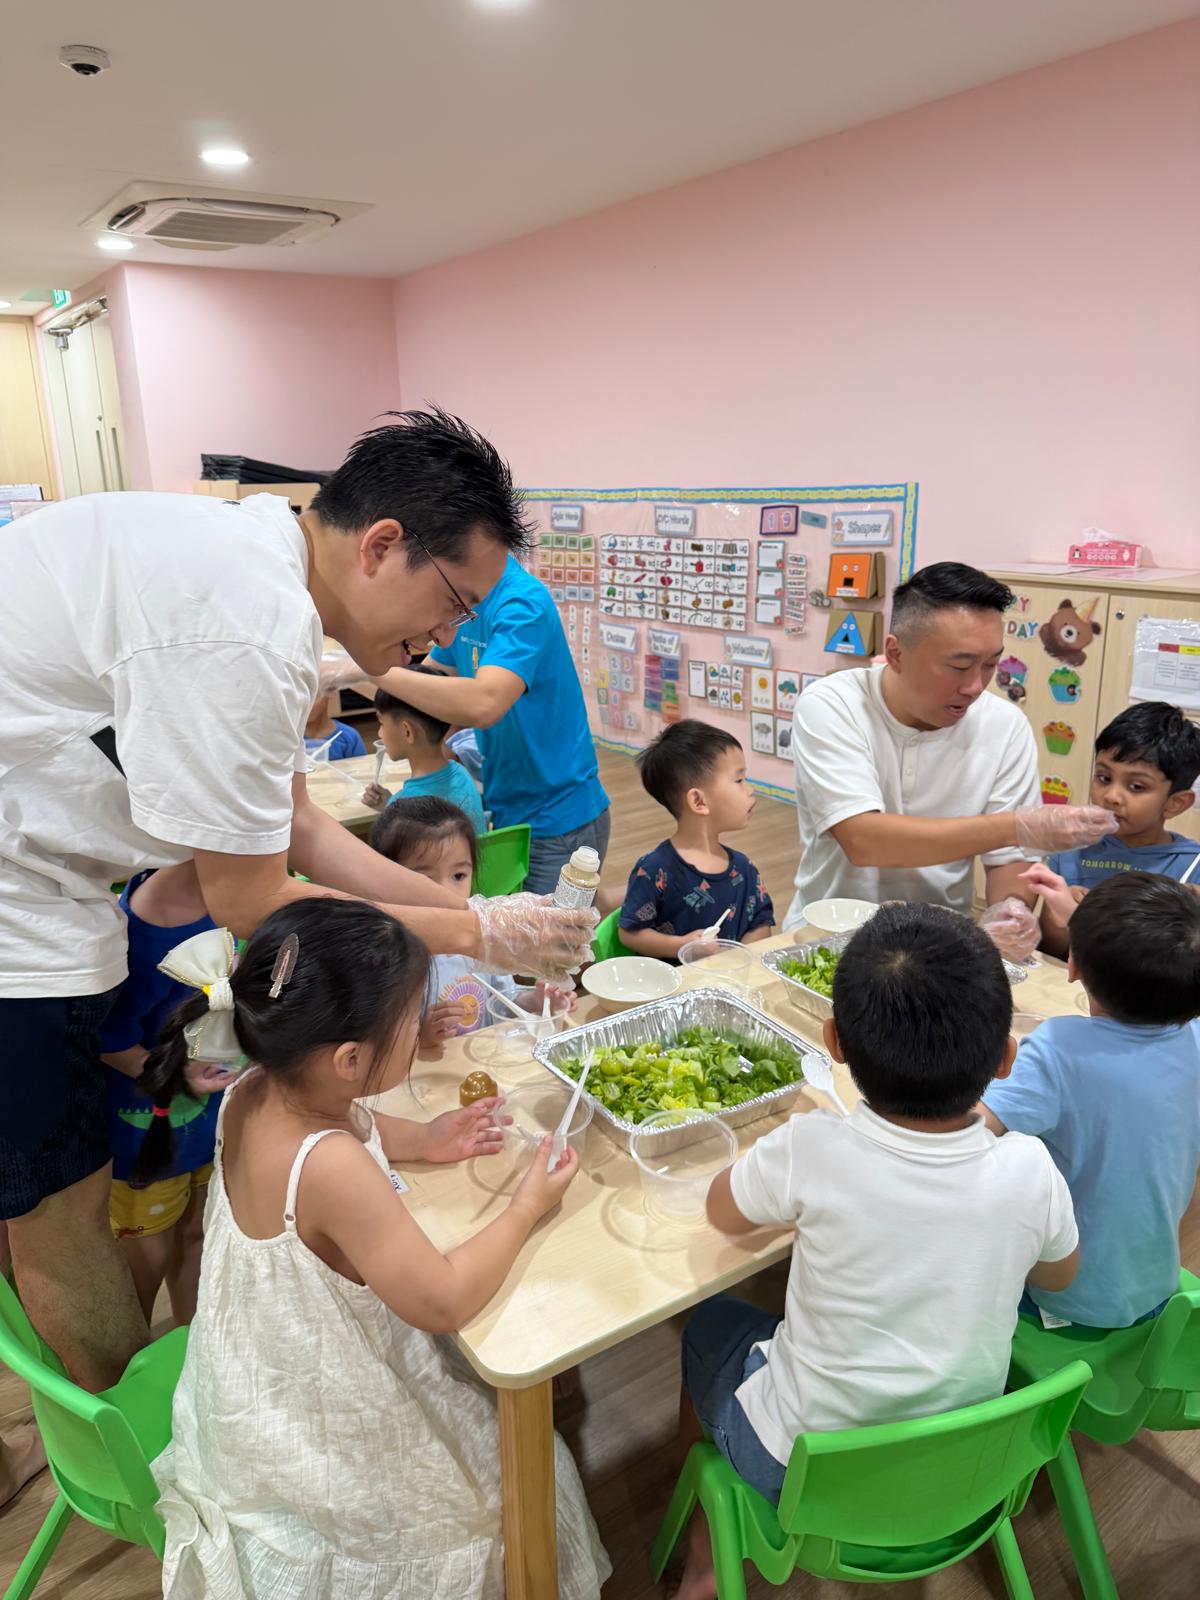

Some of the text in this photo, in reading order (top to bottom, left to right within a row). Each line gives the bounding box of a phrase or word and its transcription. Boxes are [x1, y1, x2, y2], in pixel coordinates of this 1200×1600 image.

[847, 520, 882, 537] Shapes
[732, 642, 765, 657] Weather
[1081, 859, 1131, 872] TOMORROW
